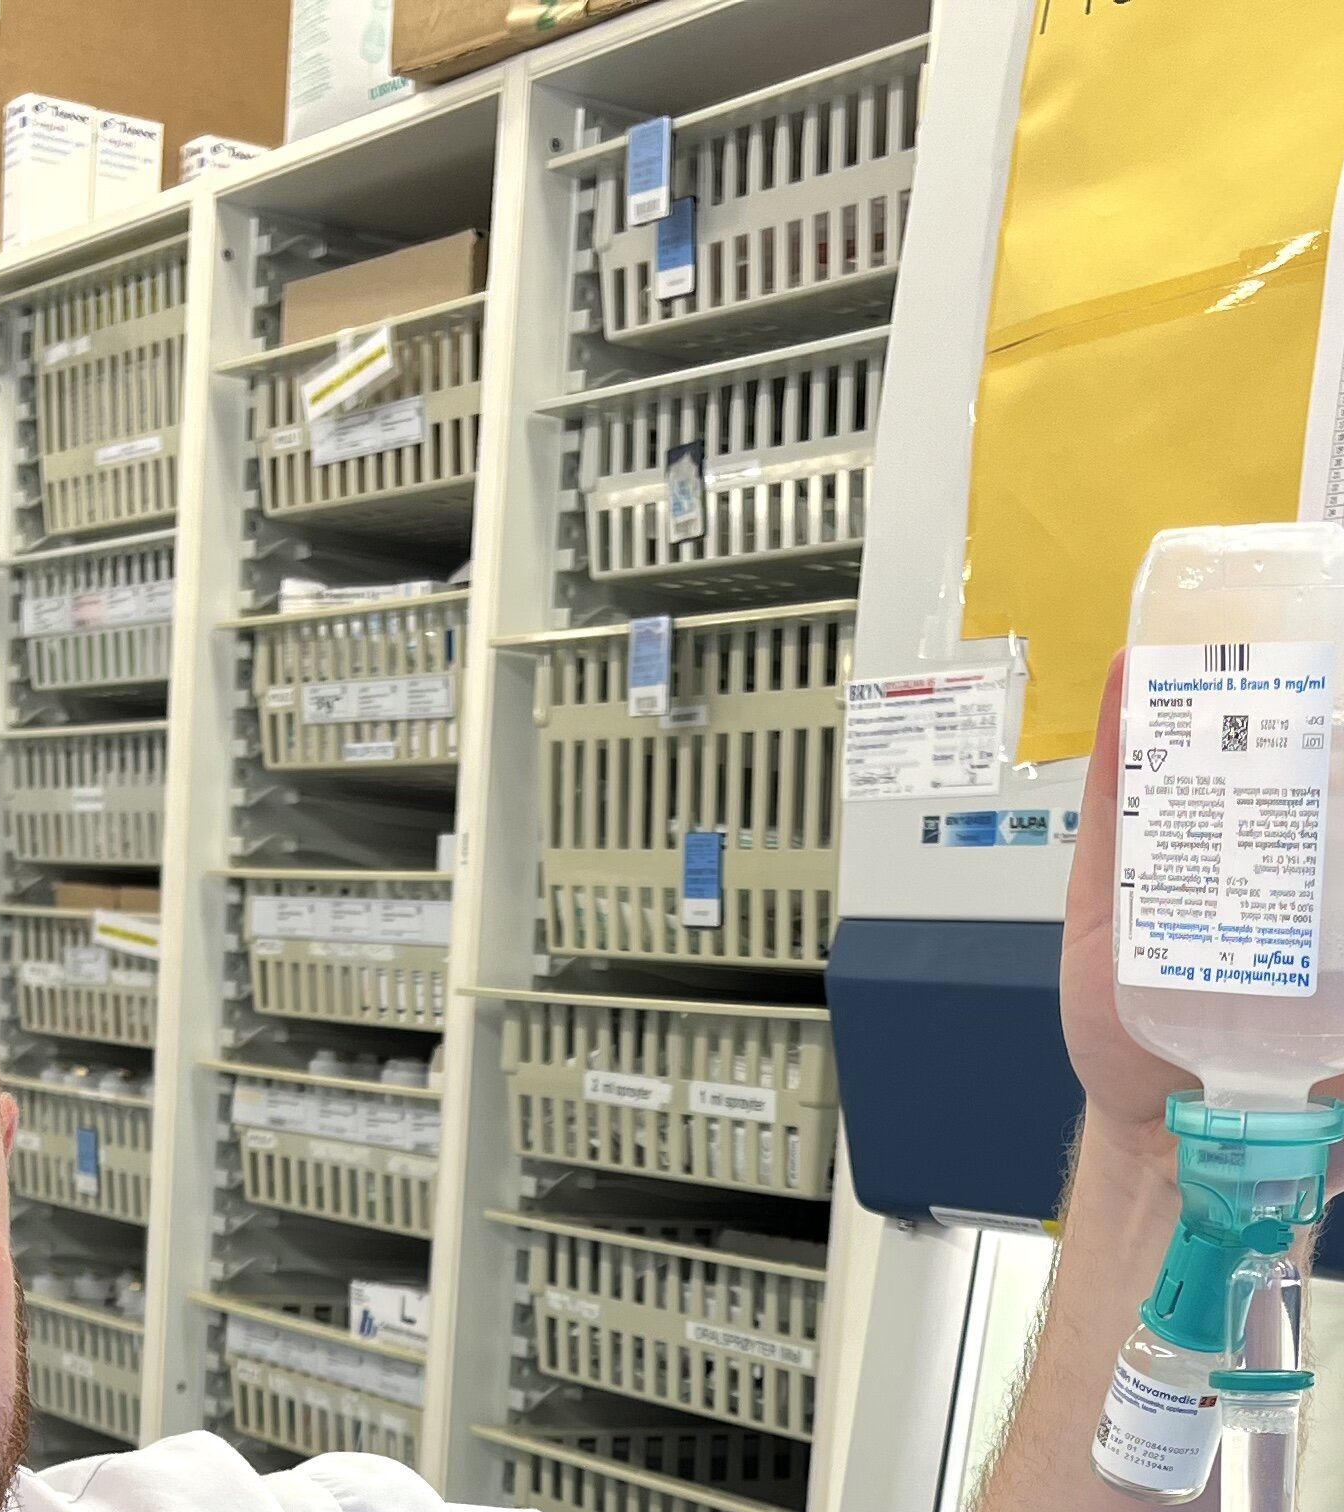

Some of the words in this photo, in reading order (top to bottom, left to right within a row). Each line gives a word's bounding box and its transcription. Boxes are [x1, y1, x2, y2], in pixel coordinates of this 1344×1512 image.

[1148, 677, 1225, 693] Natriumklorid
[1227, 677, 1237, 692] B.
[1239, 677, 1270, 691] Braun
[1273, 677, 1281, 690] 9
[1284, 674, 1326, 692] mg/ml
[1149, 698, 1183, 708] BRAUN
[1305, 736, 1321, 746] LOT
[1132, 749, 1144, 761] 50
[1127, 796, 1140, 808] 100
[1009, 816, 1047, 830] ULPA
[1124, 868, 1136, 880] 150
[1291, 914, 1312, 923] 1000
[1134, 947, 1143, 959] ml
[1144, 947, 1168, 959] 250
[1219, 951, 1235, 964] i.v.
[1253, 951, 1294, 969] mg/ml
[1301, 955, 1310, 968] 9
[1160, 965, 1195, 980] Braun
[1199, 967, 1211, 980] B.
[1215, 969, 1310, 987] Natriumklorid
[400, 1294, 417, 1326] L
[1132, 1378, 1197, 1406] Navamedic
[1142, 1450, 1165, 1461] 2025
